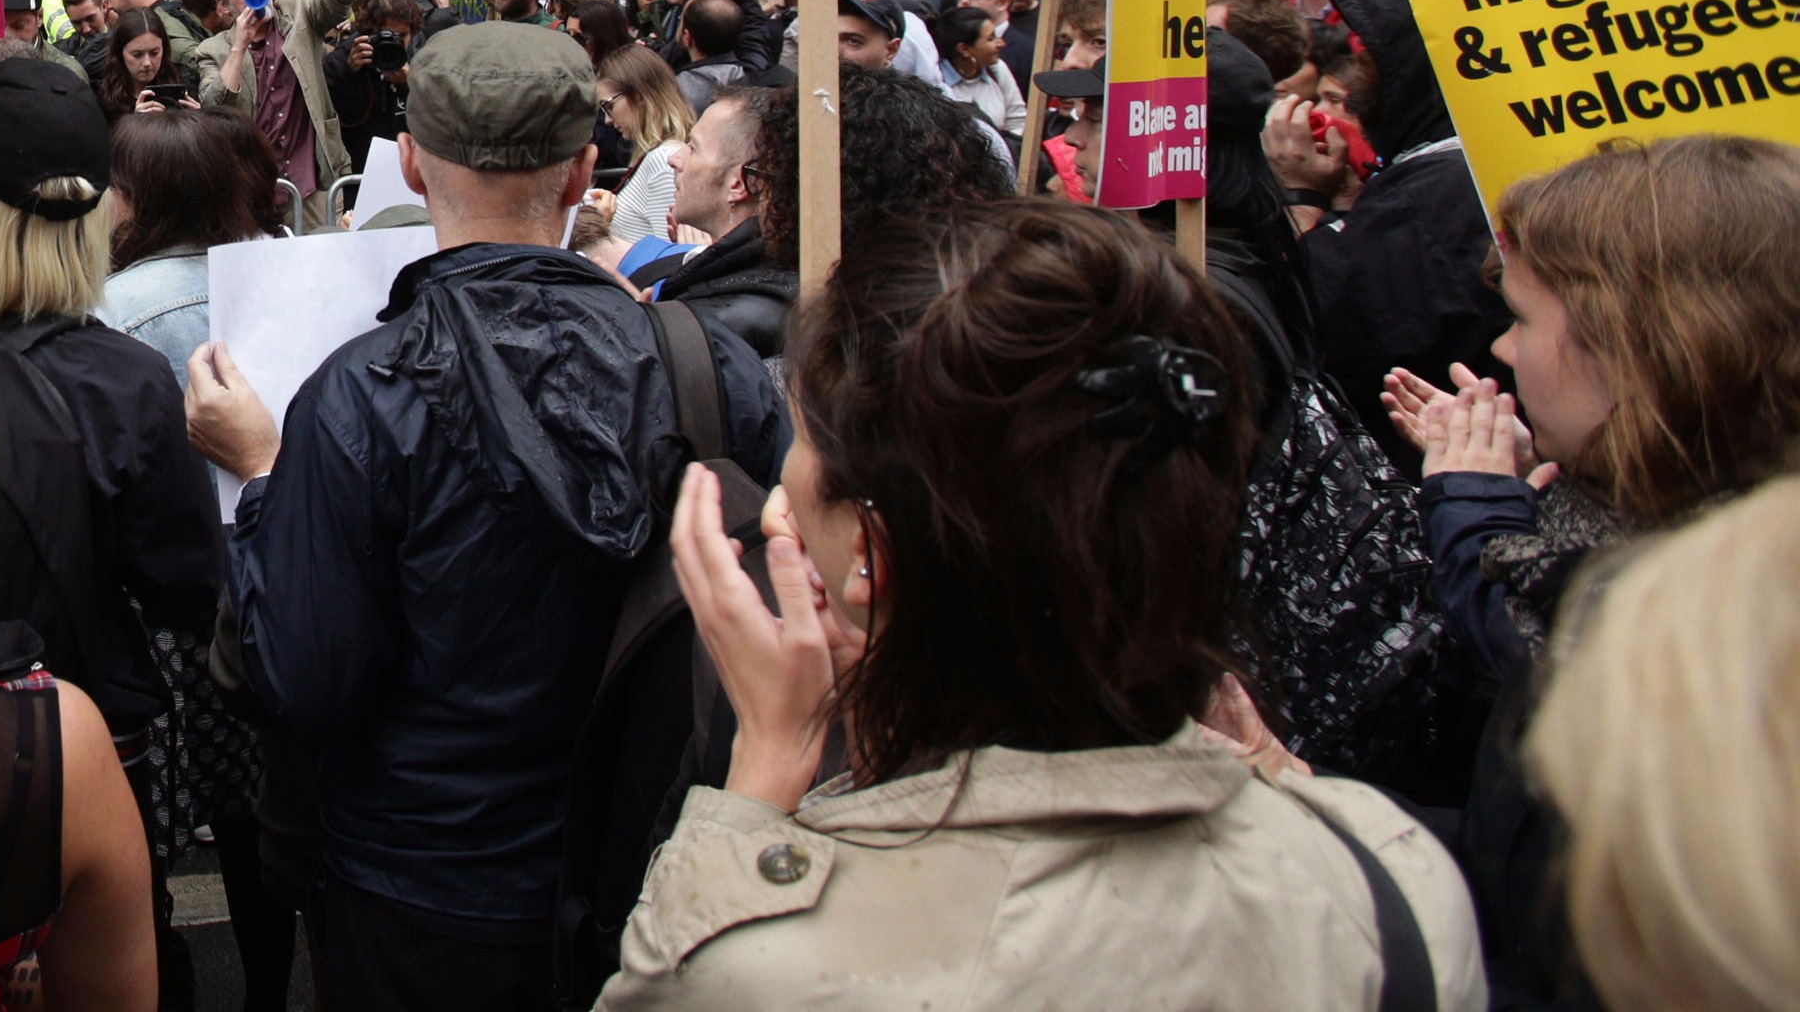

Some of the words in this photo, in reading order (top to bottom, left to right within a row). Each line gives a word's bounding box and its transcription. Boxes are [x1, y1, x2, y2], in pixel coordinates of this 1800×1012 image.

[1161, 0, 1205, 59] he
[1454, 25, 1511, 80] &
[1508, 56, 1800, 138] welcome
